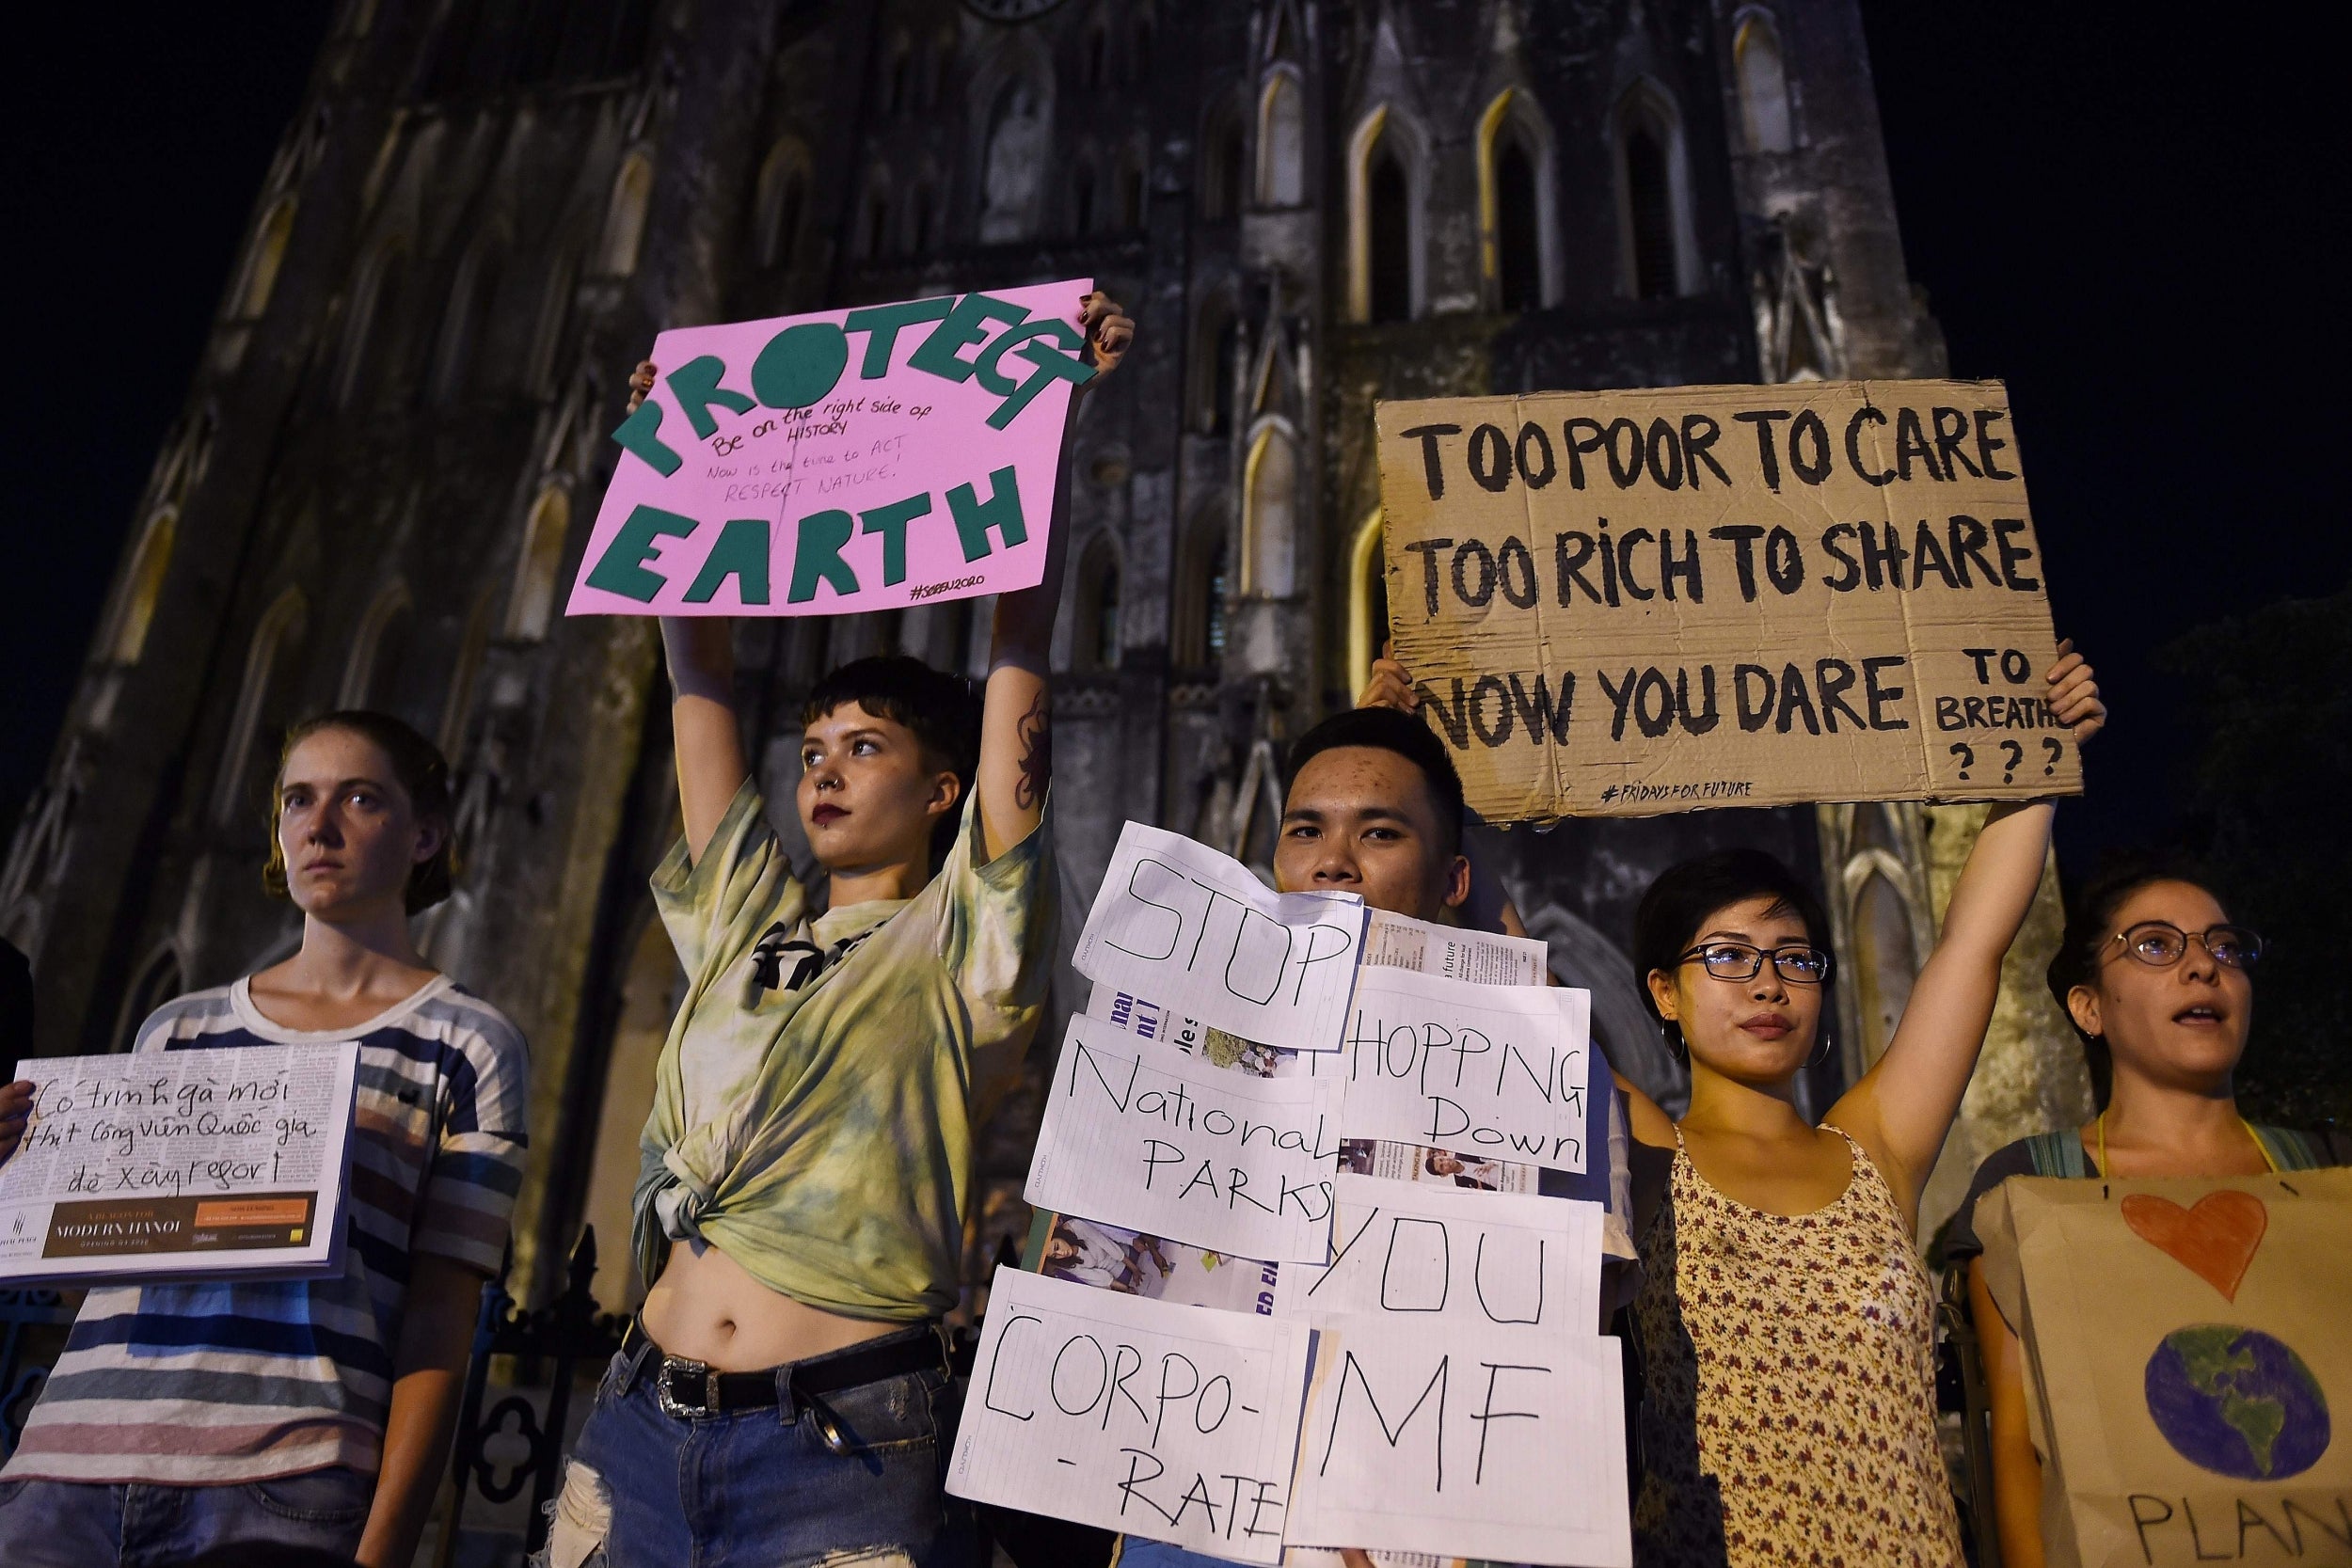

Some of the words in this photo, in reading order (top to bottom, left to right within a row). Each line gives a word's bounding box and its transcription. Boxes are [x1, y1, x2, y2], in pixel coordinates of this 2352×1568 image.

[612, 293, 1099, 478] PROTECT
[712, 436, 744, 458] Be
[753, 420, 777, 437] on
[782, 407, 813, 424] the
[823, 397, 866, 420] right
[871, 395, 901, 414] side
[771, 459, 792, 471] the
[803, 453, 834, 467] time
[844, 451, 859, 461] to
[871, 435, 908, 456] ACT
[787, 420, 848, 443] HISTORY
[1399, 420, 1555, 500] TOO
[1565, 413, 1731, 491] POOR
[1732, 408, 1832, 493] TO
[1845, 405, 2017, 487] CARE
[724, 478, 807, 502] RESPECT
[585, 465, 1028, 604] EARTH
[1404, 535, 1539, 618] TOO
[1708, 524, 1805, 602] TO
[1821, 515, 2040, 593] SHARE
[1412, 670, 1576, 751] NOW
[1597, 663, 1718, 741] YOU
[1734, 656, 1909, 736] DARE
[1962, 648, 2031, 685] TO
[1104, 858, 1351, 1006] STOP
[1442, 942, 1456, 972] future
[1173, 1029, 1196, 1055] le
[1311, 1010, 1586, 1117] HOPPING
[1069, 1039, 1339, 1162] National
[1423, 1096, 1581, 1164] Down
[1143, 1139, 1332, 1223] PARKS
[56, 1223, 122, 1238] MODERN
[129, 1220, 181, 1235] HANOI
[1307, 1207, 1545, 1324] YOU
[1320, 1351, 1552, 1494] MF
[2127, 1494, 2352, 1567] PLAN
